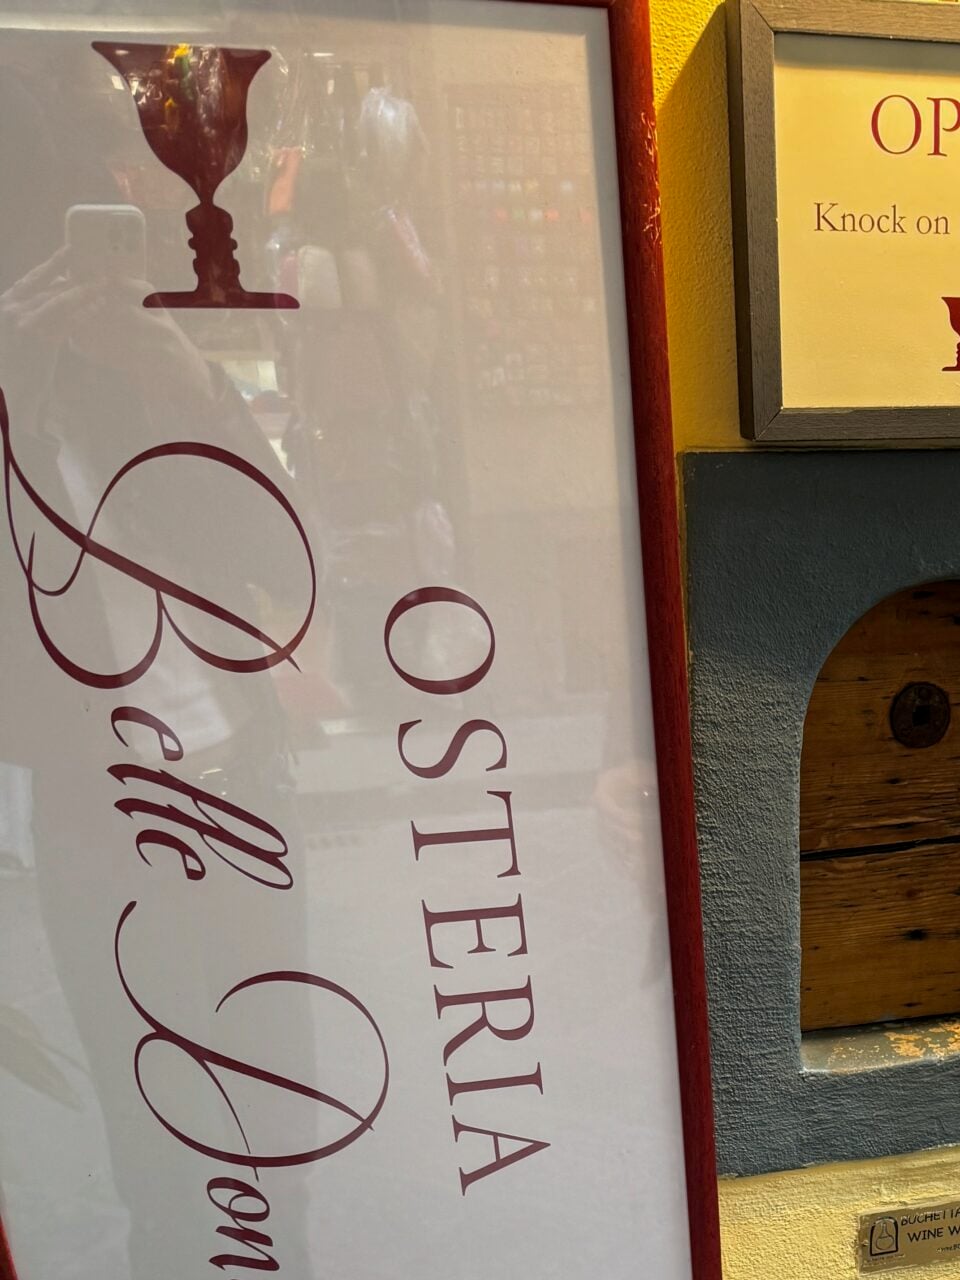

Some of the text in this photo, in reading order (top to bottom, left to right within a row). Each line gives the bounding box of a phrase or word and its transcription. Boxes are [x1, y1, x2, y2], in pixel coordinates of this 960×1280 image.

[813, 202, 907, 234] Knock
[916, 214, 950, 235] on
[0, 386, 316, 890] Belle
[384, 585, 551, 1197] OSTERIA
[907, 1226, 944, 1243] WINE
